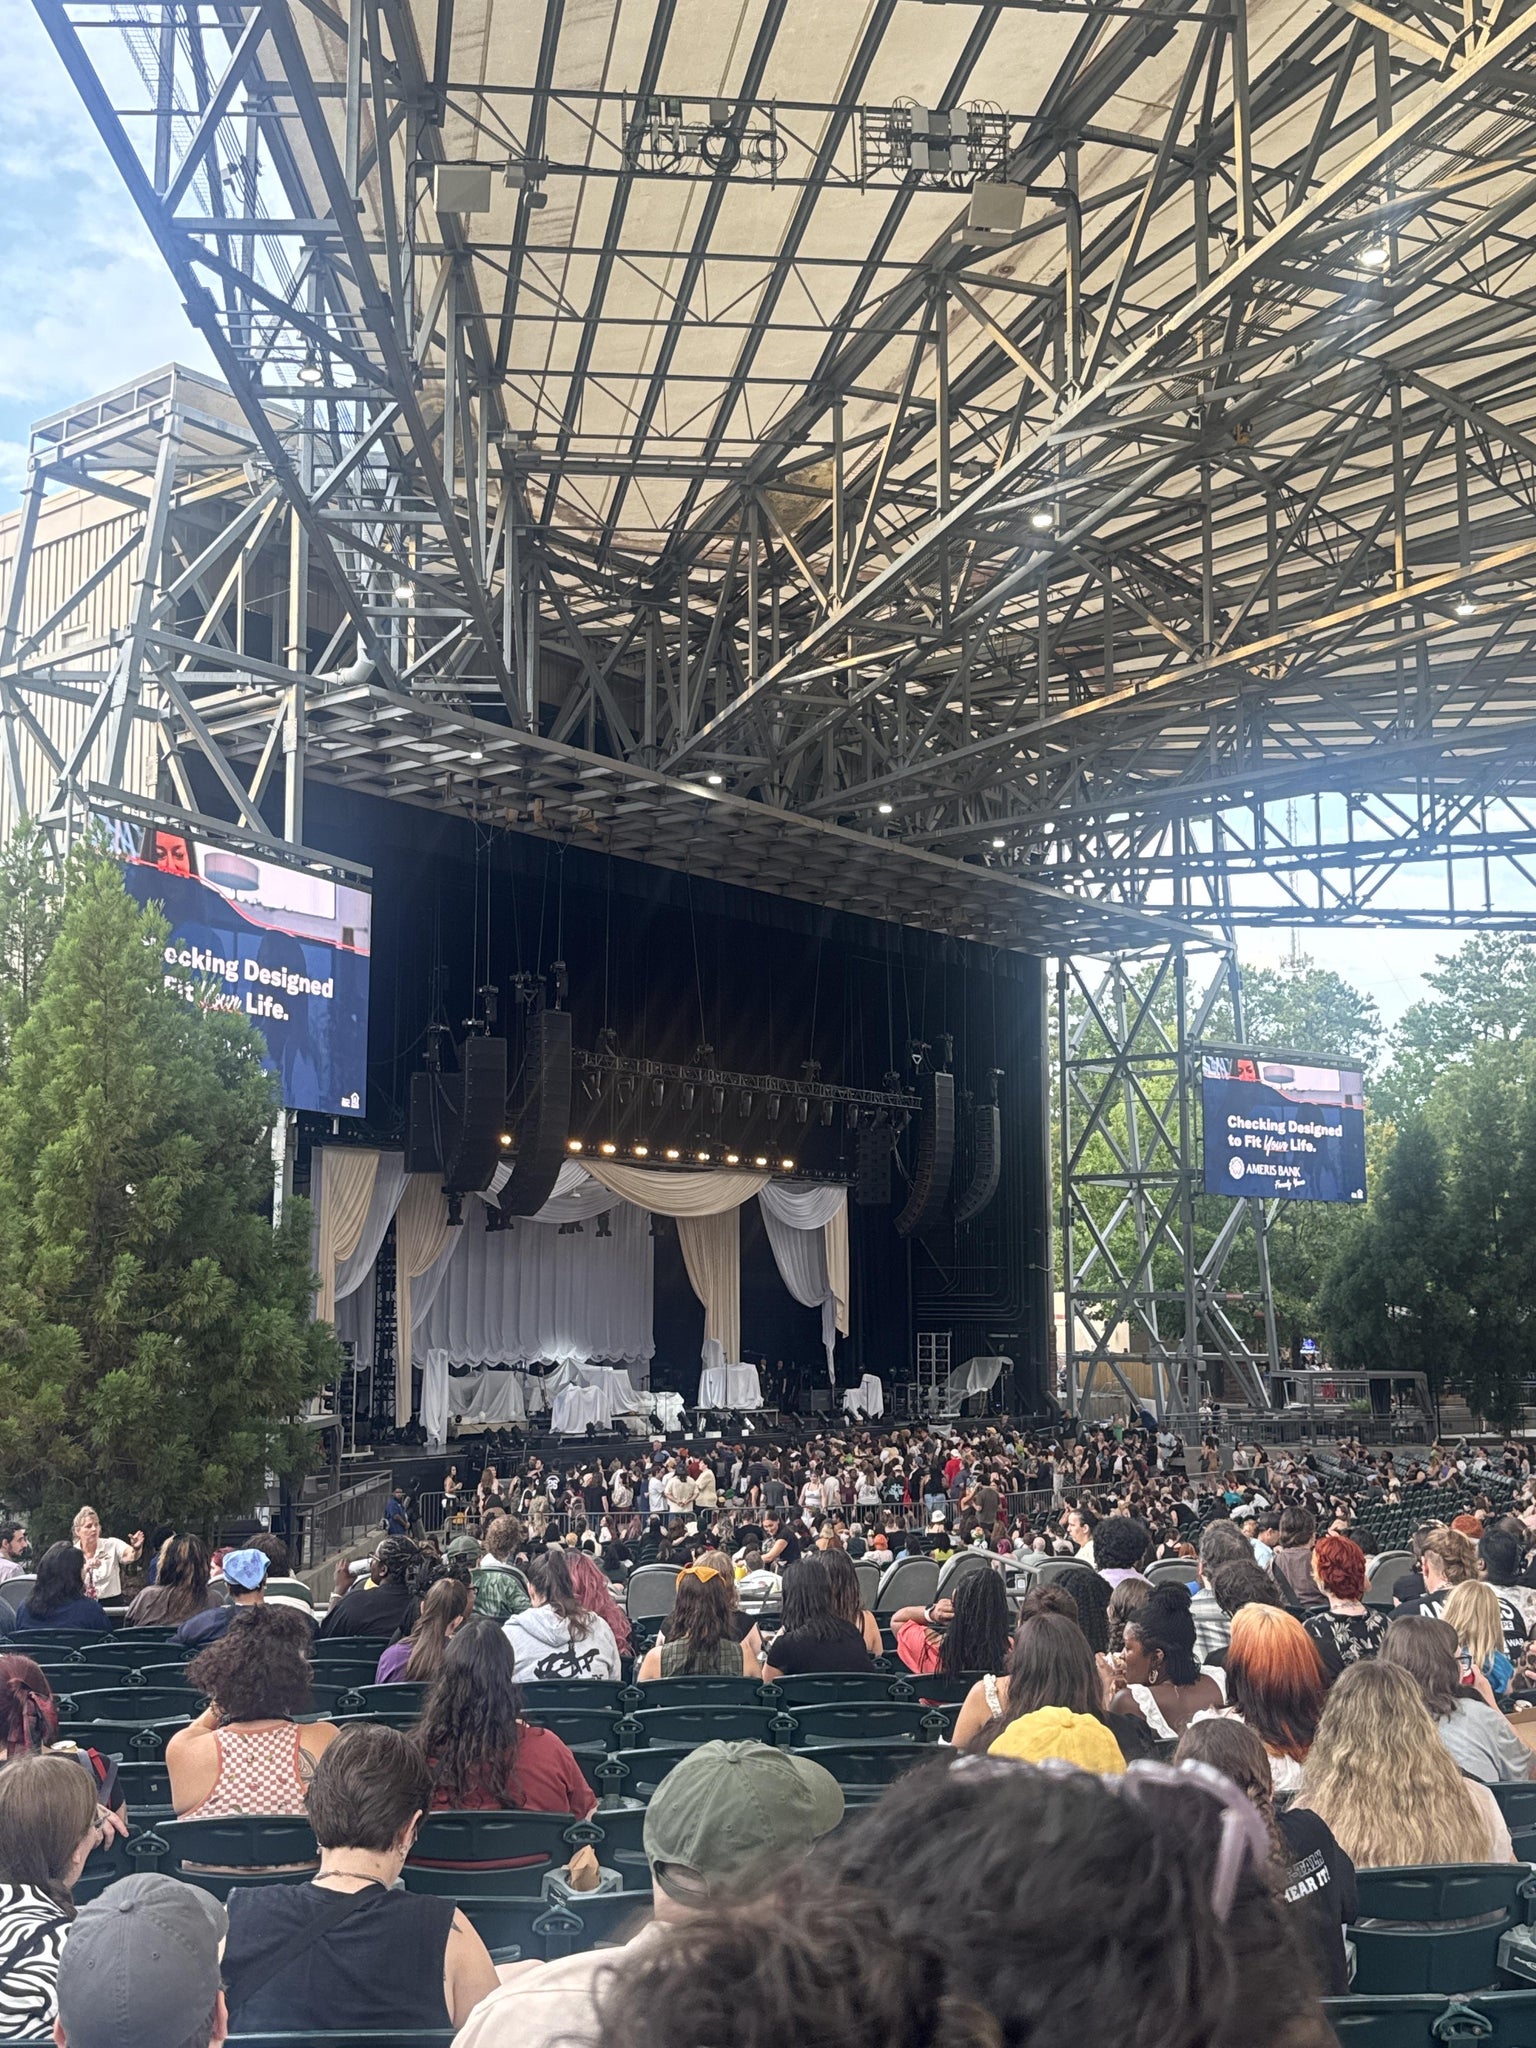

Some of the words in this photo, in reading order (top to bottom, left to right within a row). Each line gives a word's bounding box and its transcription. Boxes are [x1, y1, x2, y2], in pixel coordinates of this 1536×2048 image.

[142, 936, 240, 983] ecking
[244, 958, 334, 999] Designed
[245, 991, 289, 1021] Life.
[1227, 1115, 1286, 1135] Checking
[1288, 1120, 1343, 1138] Designed
[1227, 1134, 1242, 1147] to
[1244, 1135, 1262, 1148] Fit
[1290, 1138, 1317, 1152] Life.
[1246, 1163, 1277, 1176] AMERIS
[1278, 1165, 1301, 1177] BANK
